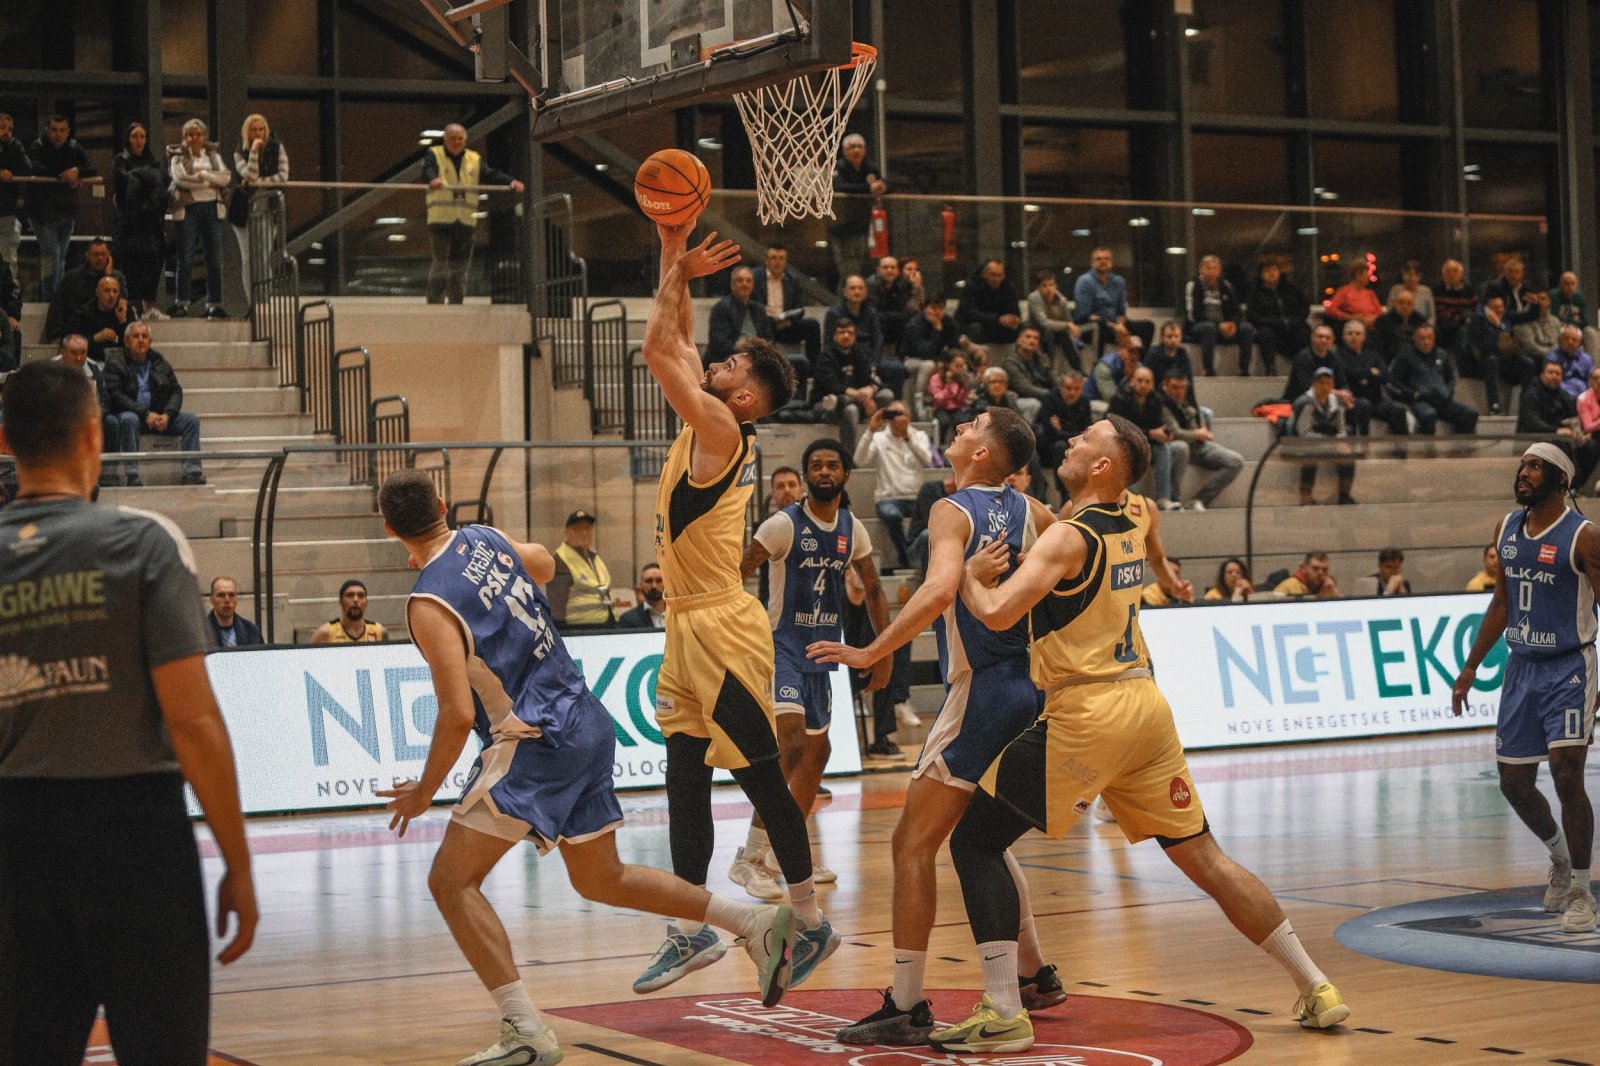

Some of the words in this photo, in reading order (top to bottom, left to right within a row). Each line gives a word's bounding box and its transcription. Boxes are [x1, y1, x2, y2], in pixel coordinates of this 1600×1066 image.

[813, 568, 826, 595] 4
[1117, 565, 1135, 586] PSK
[1504, 565, 1556, 585] ALKAR
[0, 570, 106, 620] GRAWE
[1518, 581, 1533, 612] 0
[1530, 631, 1556, 645] ALKAR
[1227, 719, 1274, 735] NOVE
[1282, 711, 1390, 731] ENERGETSKE
[1564, 708, 1580, 738] 0
[316, 777, 380, 797] NOVE
